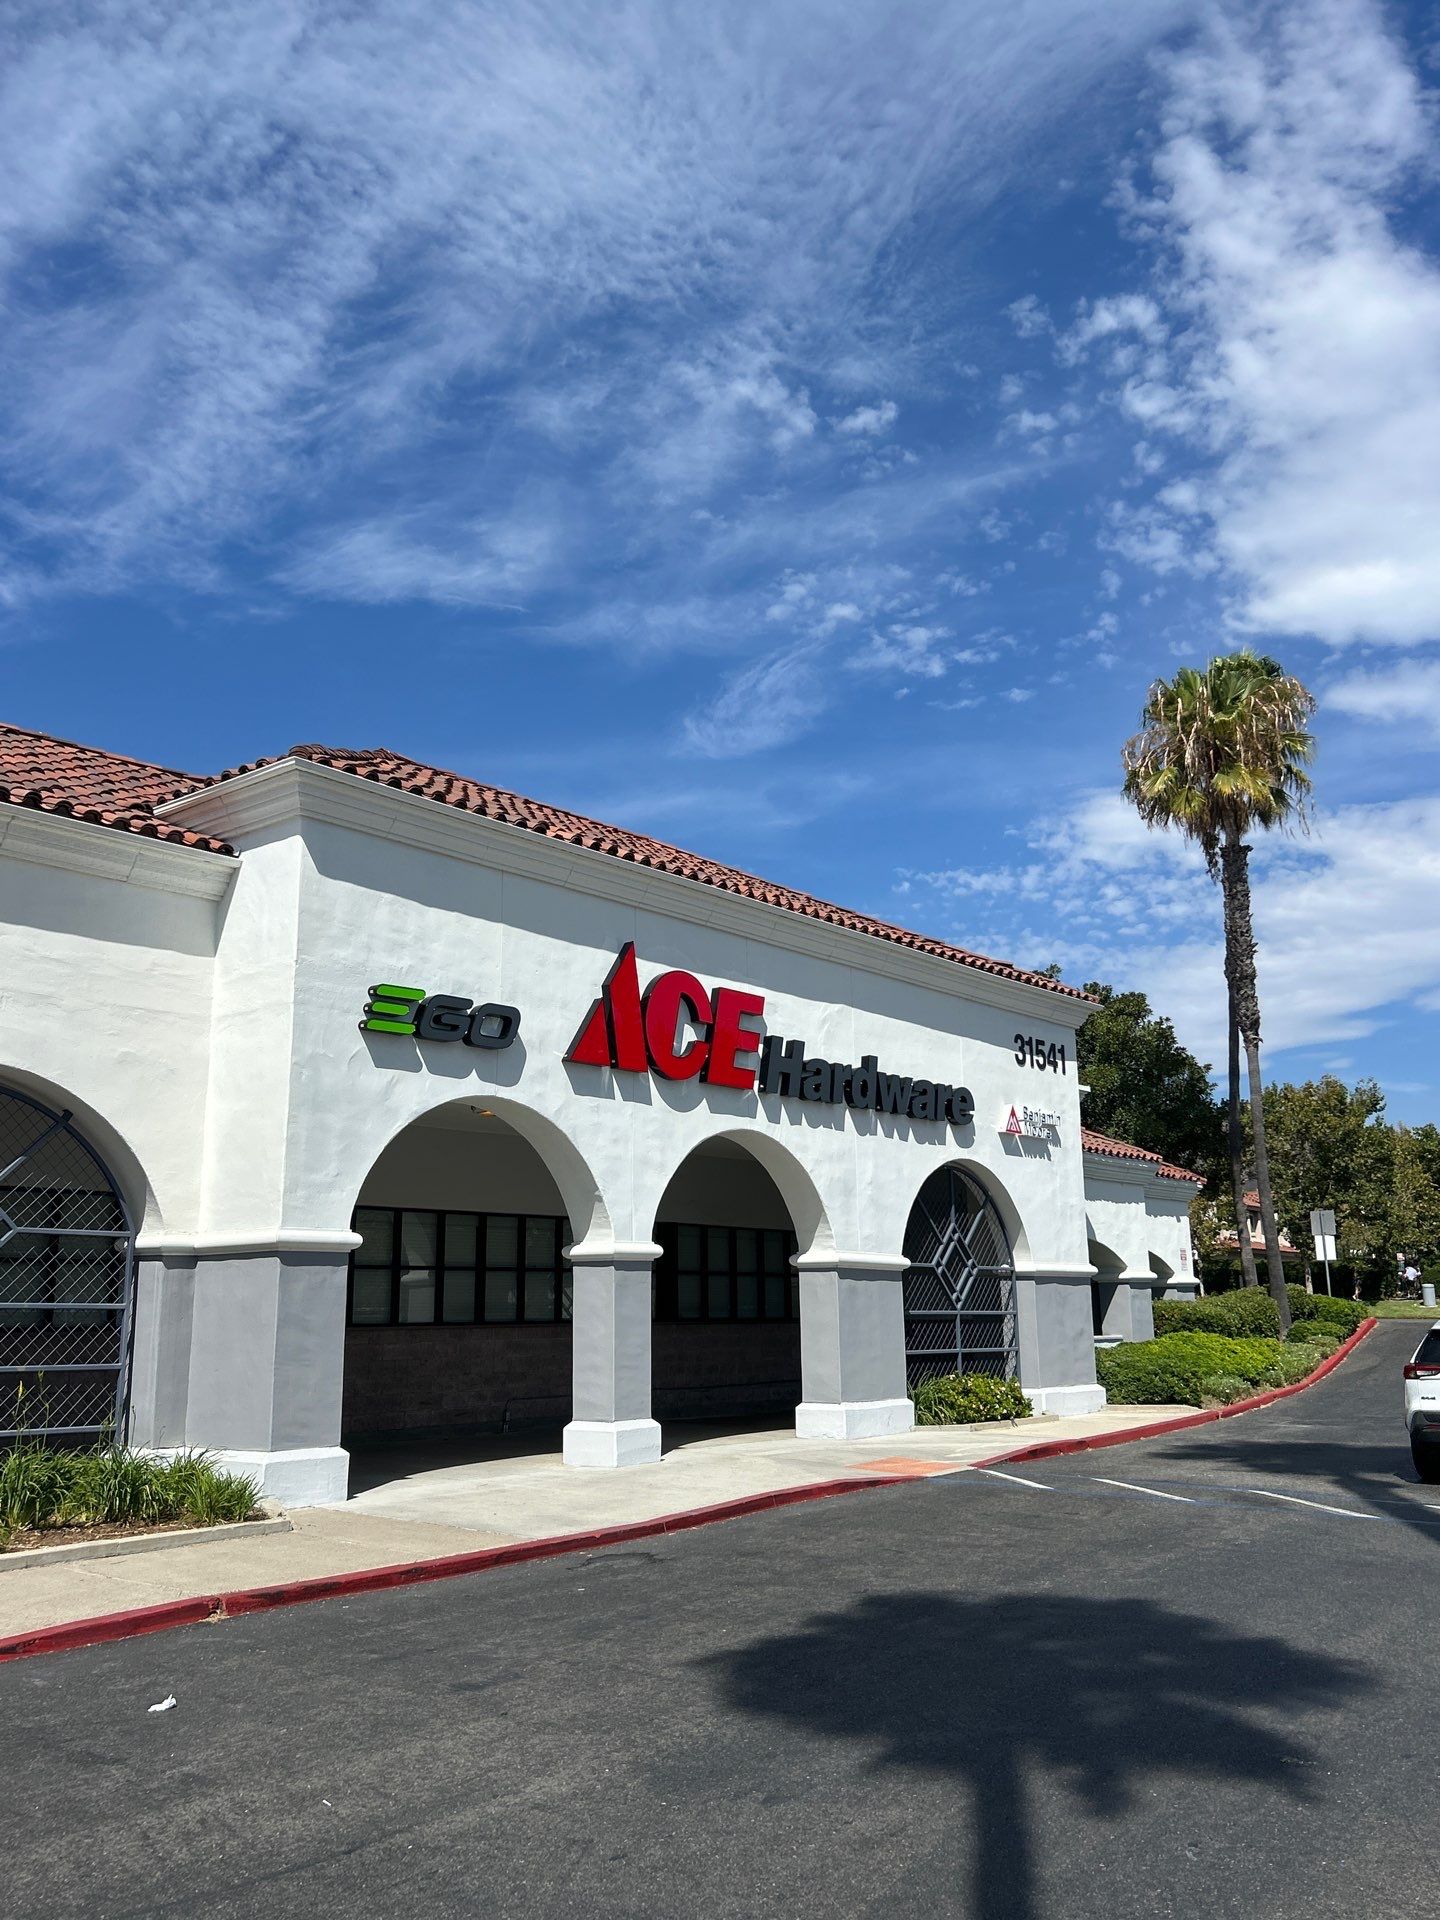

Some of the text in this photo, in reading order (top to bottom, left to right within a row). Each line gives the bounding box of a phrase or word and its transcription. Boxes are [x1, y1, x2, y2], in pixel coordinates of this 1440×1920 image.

[358, 983, 522, 1050] EGO
[561, 941, 976, 1126] ACE Hardware
[1013, 1033, 1067, 1076] 31541
[1023, 1106, 1061, 1126] Benjamin
[1024, 1120, 1052, 1139] Moore
